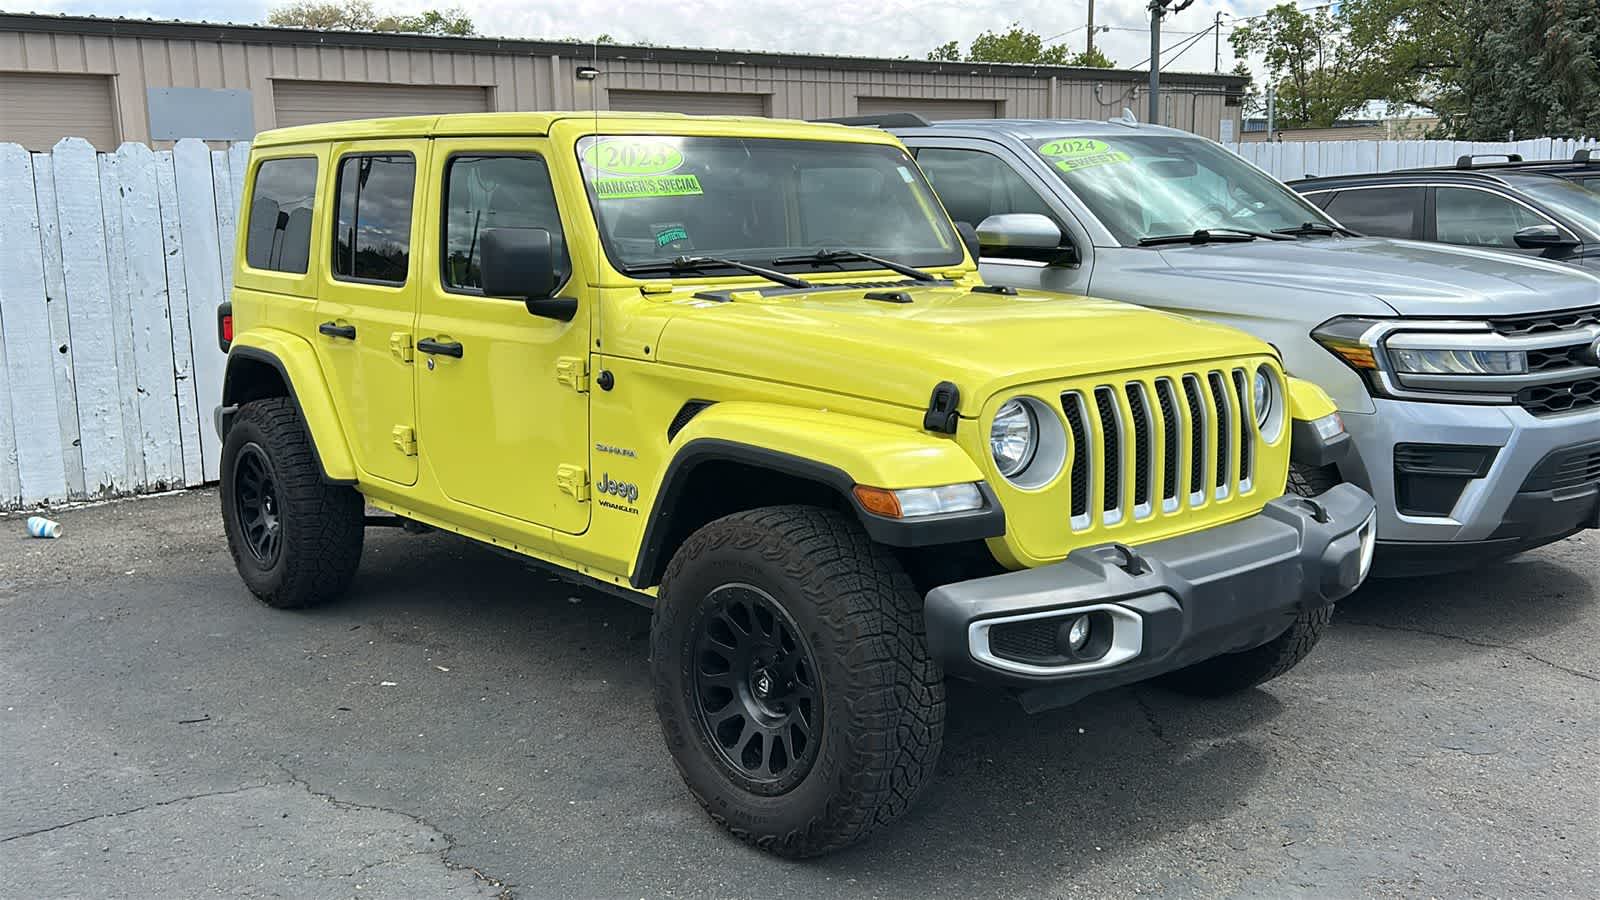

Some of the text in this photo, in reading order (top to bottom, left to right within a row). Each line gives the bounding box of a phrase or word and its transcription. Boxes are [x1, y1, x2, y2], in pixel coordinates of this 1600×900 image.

[1051, 140, 1096, 155] 2024
[604, 145, 667, 168] 2023
[597, 177, 700, 195] MANAGER'S SPECIAL
[596, 443, 637, 459] SAHARA
[597, 472, 639, 504] Jeep
[599, 499, 639, 515] WRANGLER
